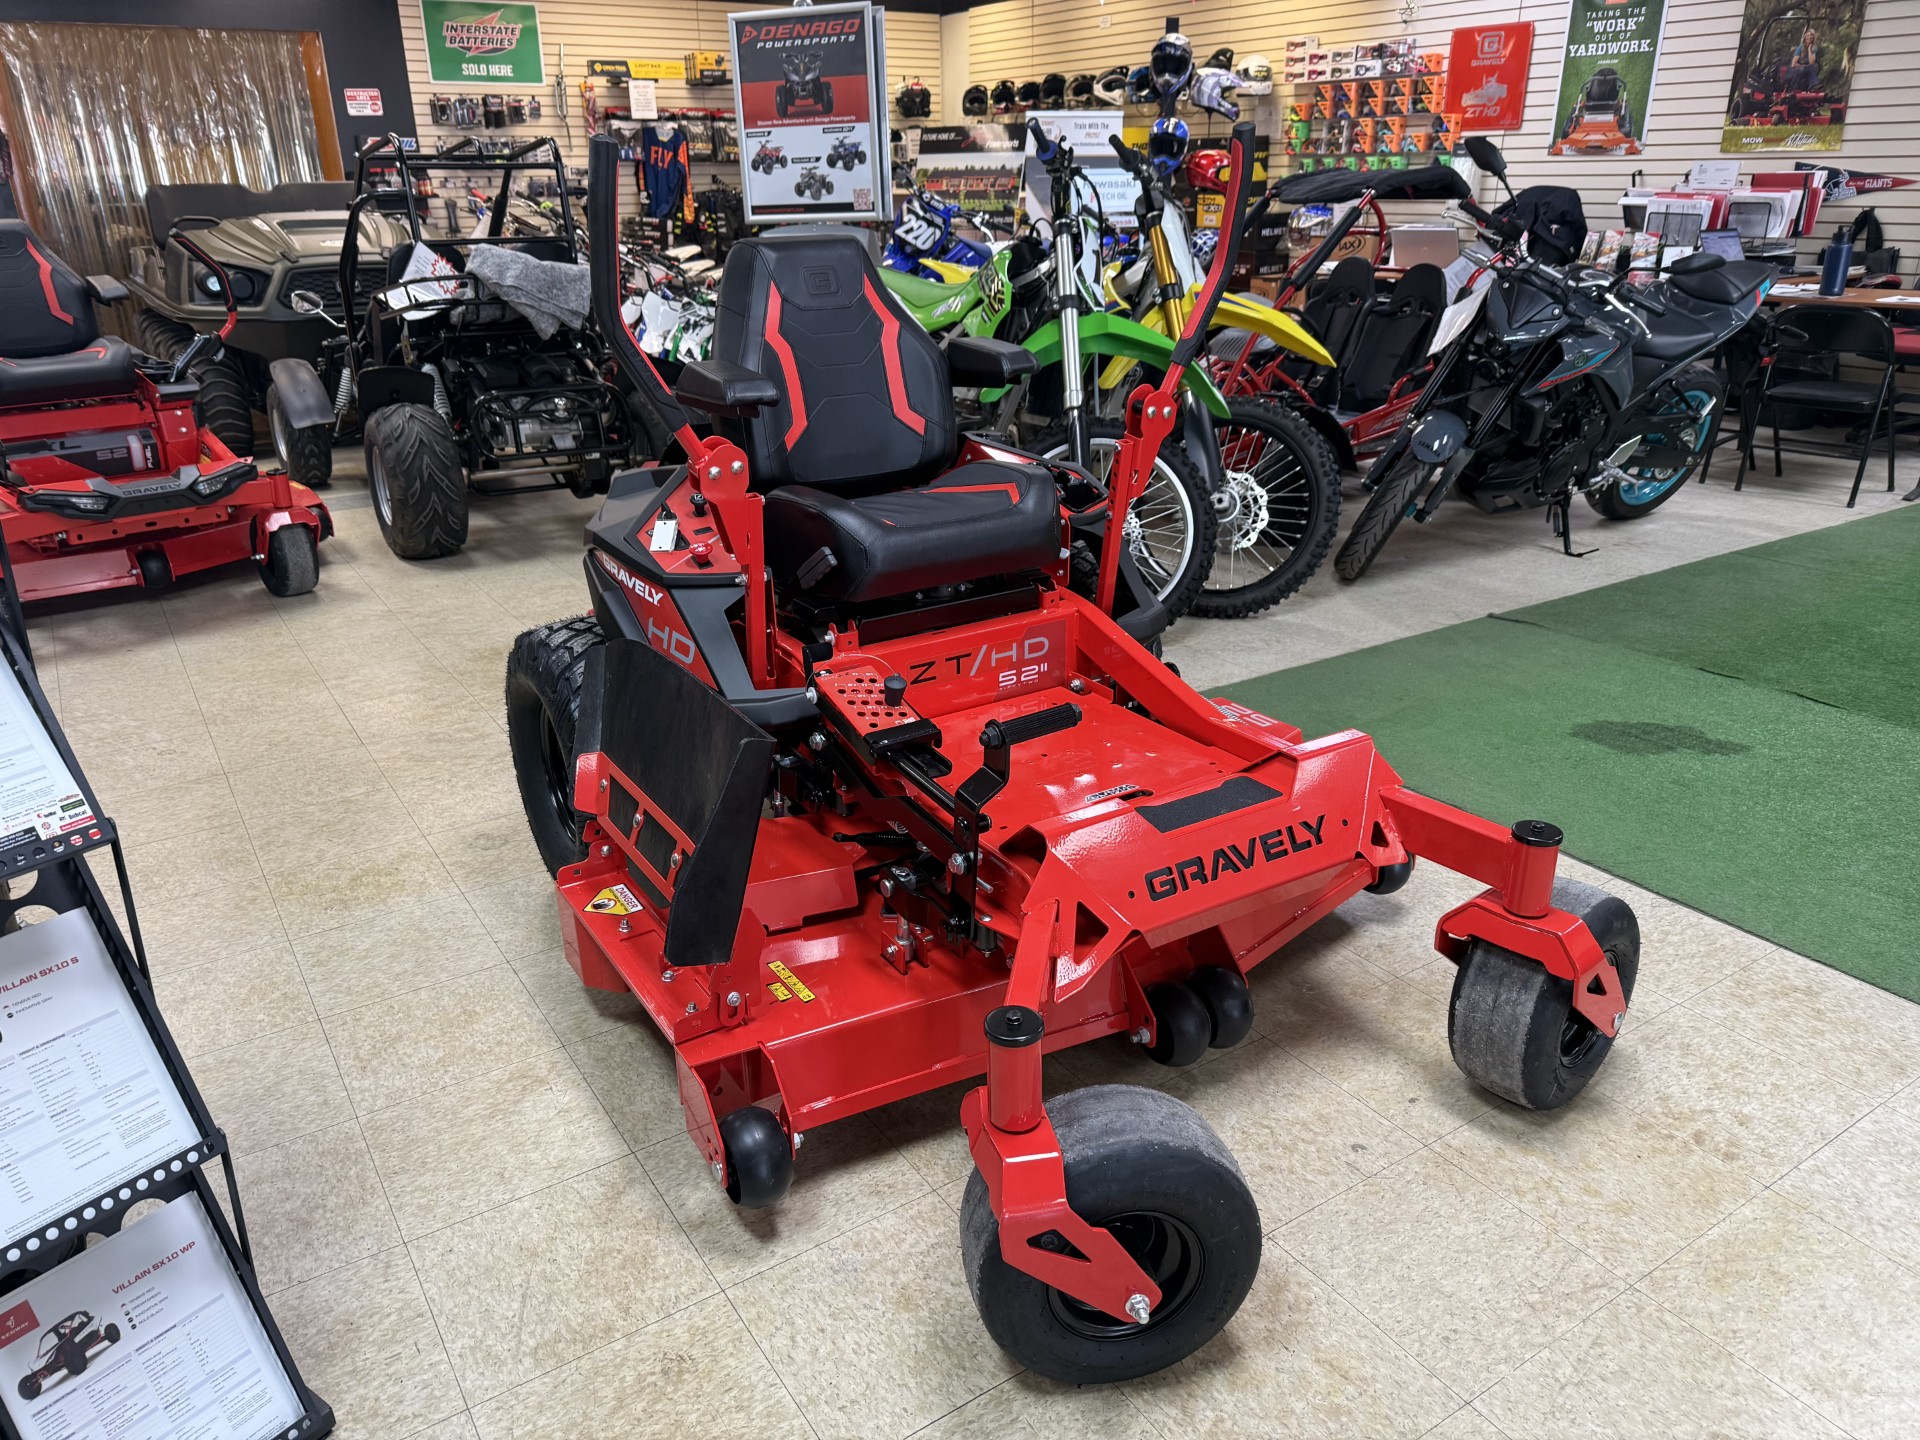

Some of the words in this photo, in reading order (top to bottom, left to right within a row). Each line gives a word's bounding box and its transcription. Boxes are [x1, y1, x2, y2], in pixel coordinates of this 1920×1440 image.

[1586, 9, 1621, 19] TAKING
[1627, 6, 1647, 16] THE
[446, 24, 517, 36] INTERSTATE
[759, 19, 861, 40] DENAGO
[1595, 33, 1613, 42] OUT
[1619, 31, 1632, 40] OF
[449, 36, 513, 46] BATTERIES
[756, 34, 856, 49] POWERSPORTS
[1568, 39, 1654, 57] YARDWORK.
[1471, 58, 1505, 67] GRAVELY
[462, 63, 487, 76] SOLD
[489, 64, 514, 77] HERE
[1741, 136, 1764, 144] MOW
[650, 145, 674, 169] FLY
[1082, 178, 1136, 189] Kwasaki
[1864, 178, 1893, 188] GIANTS
[895, 214, 941, 250] 220
[1261, 227, 1287, 238] HELMET
[96, 448, 128, 461] 52
[122, 483, 183, 496] GRAVELY
[602, 554, 664, 606] GRAVELY
[647, 617, 696, 664] HD
[1144, 814, 1326, 902] GRAVELY
[615, 886, 639, 909] DANGER
[0, 973, 38, 994] ILLAIN
[39, 960, 70, 978] SX10
[70, 956, 79, 965] S
[111, 1268, 151, 1294] VILLAIN
[152, 1251, 179, 1272] SX10
[179, 1241, 196, 1254] WP
[0, 1321, 29, 1340] SEGWAY
